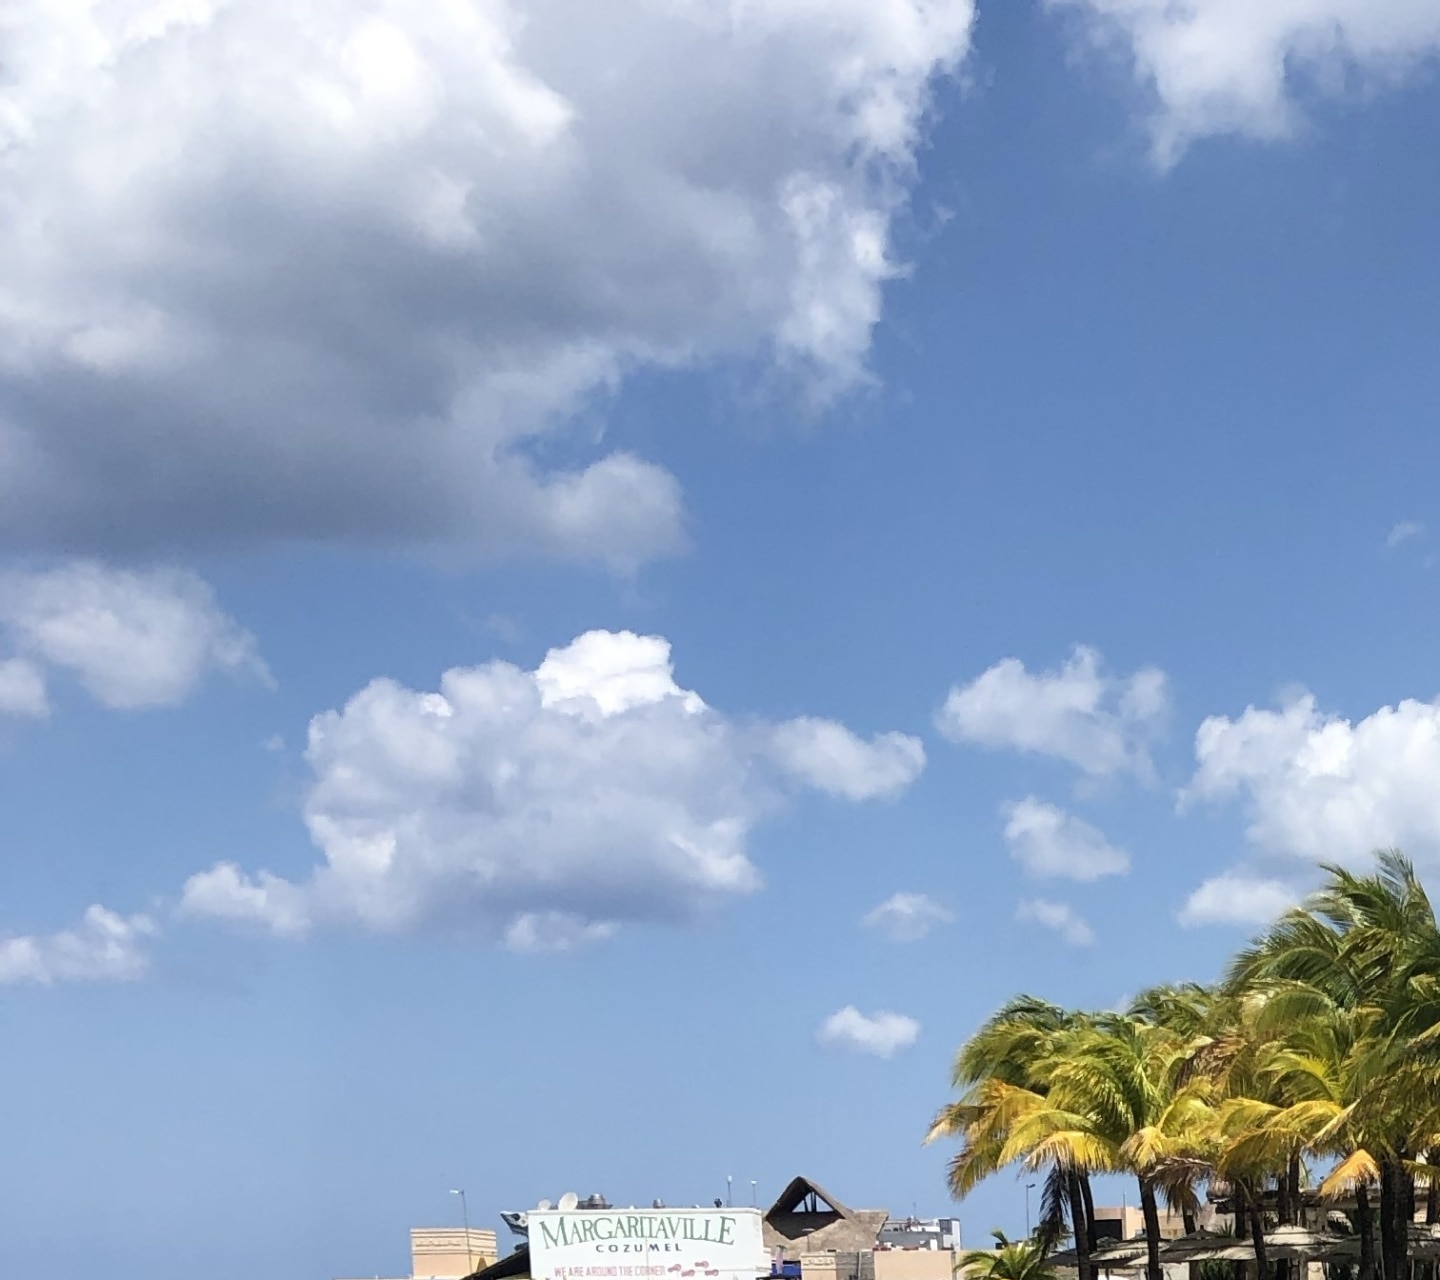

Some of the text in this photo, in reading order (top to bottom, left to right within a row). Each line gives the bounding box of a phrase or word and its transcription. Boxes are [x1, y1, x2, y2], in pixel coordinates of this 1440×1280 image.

[540, 1216, 736, 1249] MARGARITAVILLE
[596, 1243, 682, 1253] COZUMEL
[554, 1266, 665, 1277] WE ARE AROUND THE CORNER
